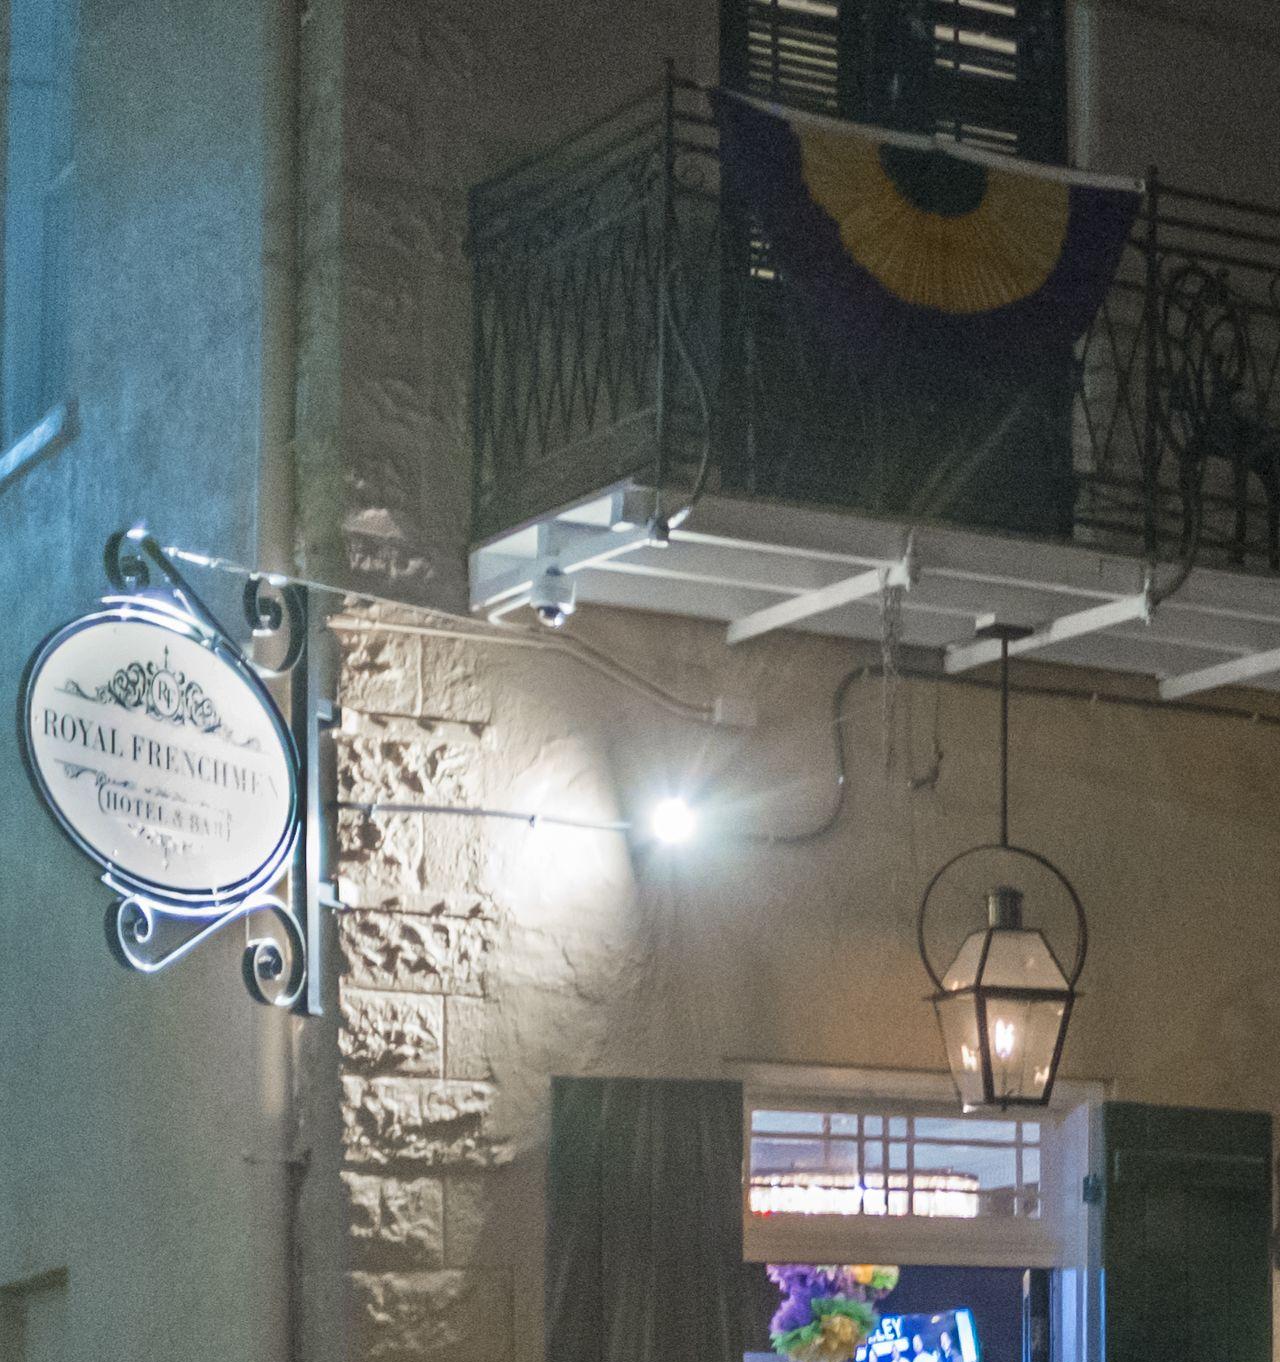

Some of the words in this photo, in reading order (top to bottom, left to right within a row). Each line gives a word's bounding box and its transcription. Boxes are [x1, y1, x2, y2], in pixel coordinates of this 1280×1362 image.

[44, 709, 123, 757] ROYAL
[131, 735, 278, 799] FRENCHMEN
[106, 790, 168, 823] HOTEL
[172, 809, 183, 829] &
[190, 813, 224, 839] BAR
